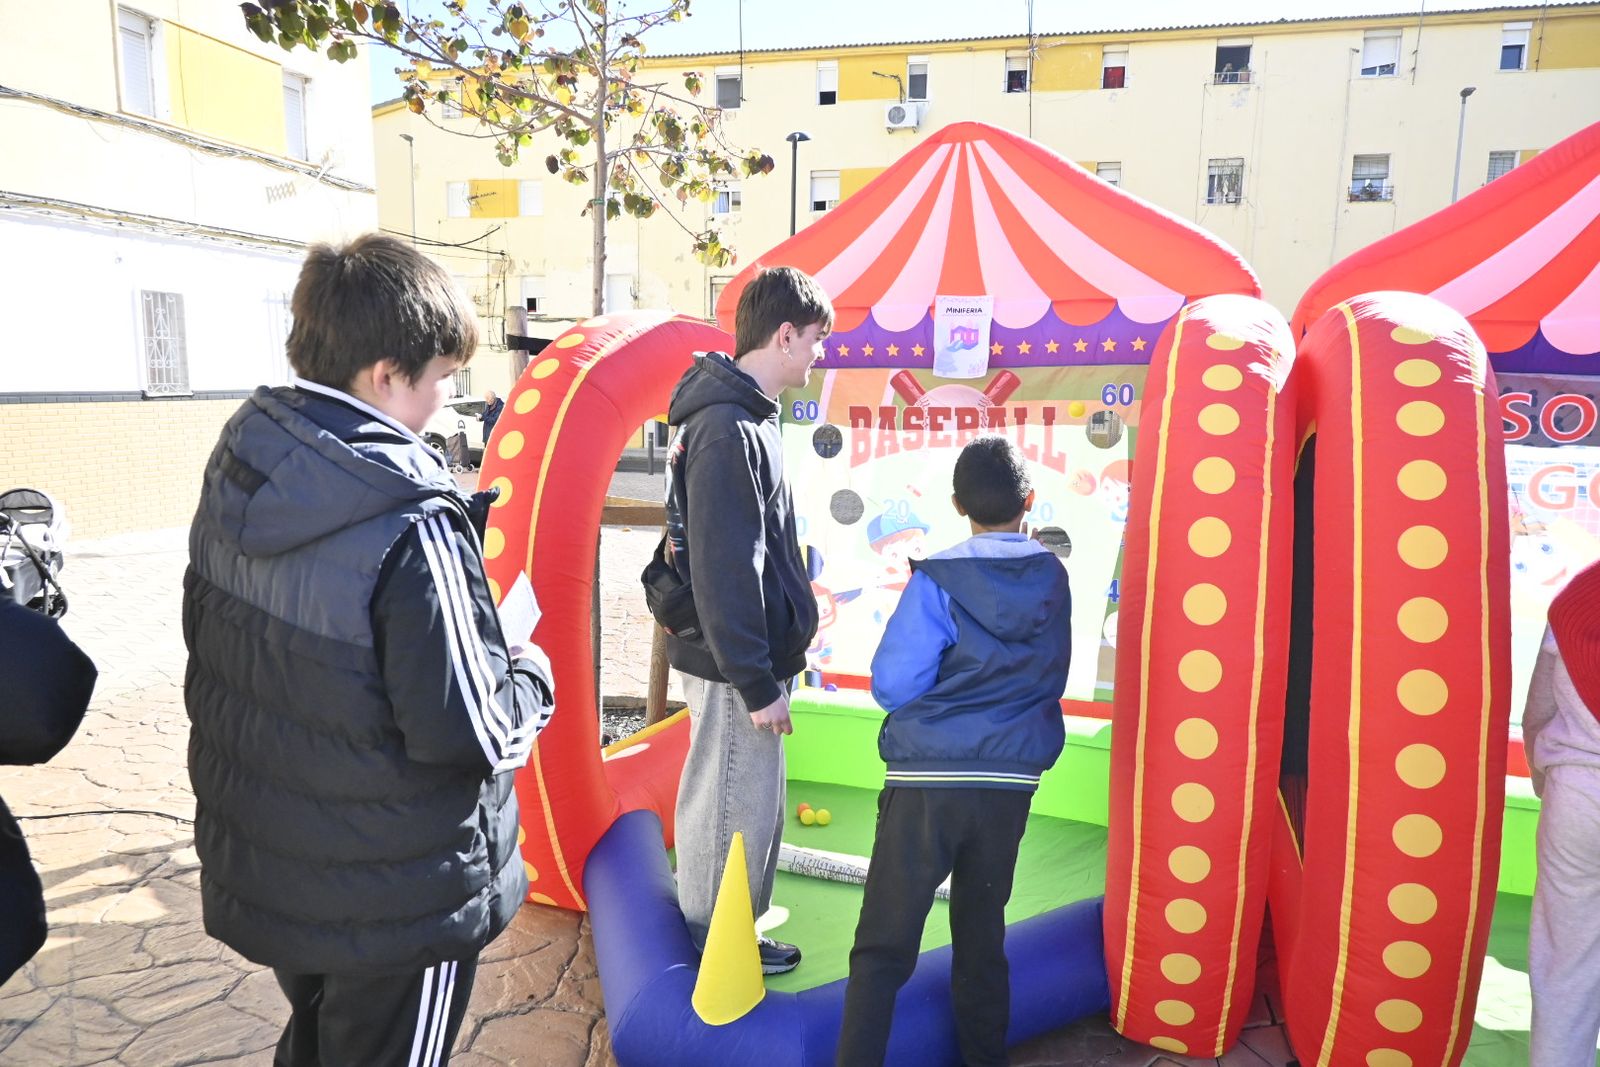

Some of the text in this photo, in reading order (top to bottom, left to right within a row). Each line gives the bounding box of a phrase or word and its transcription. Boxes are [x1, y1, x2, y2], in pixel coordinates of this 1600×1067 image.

[1102, 384, 1134, 406] 60
[792, 401, 819, 421] 60
[1529, 465, 1600, 510] G
[883, 499, 910, 518] 20
